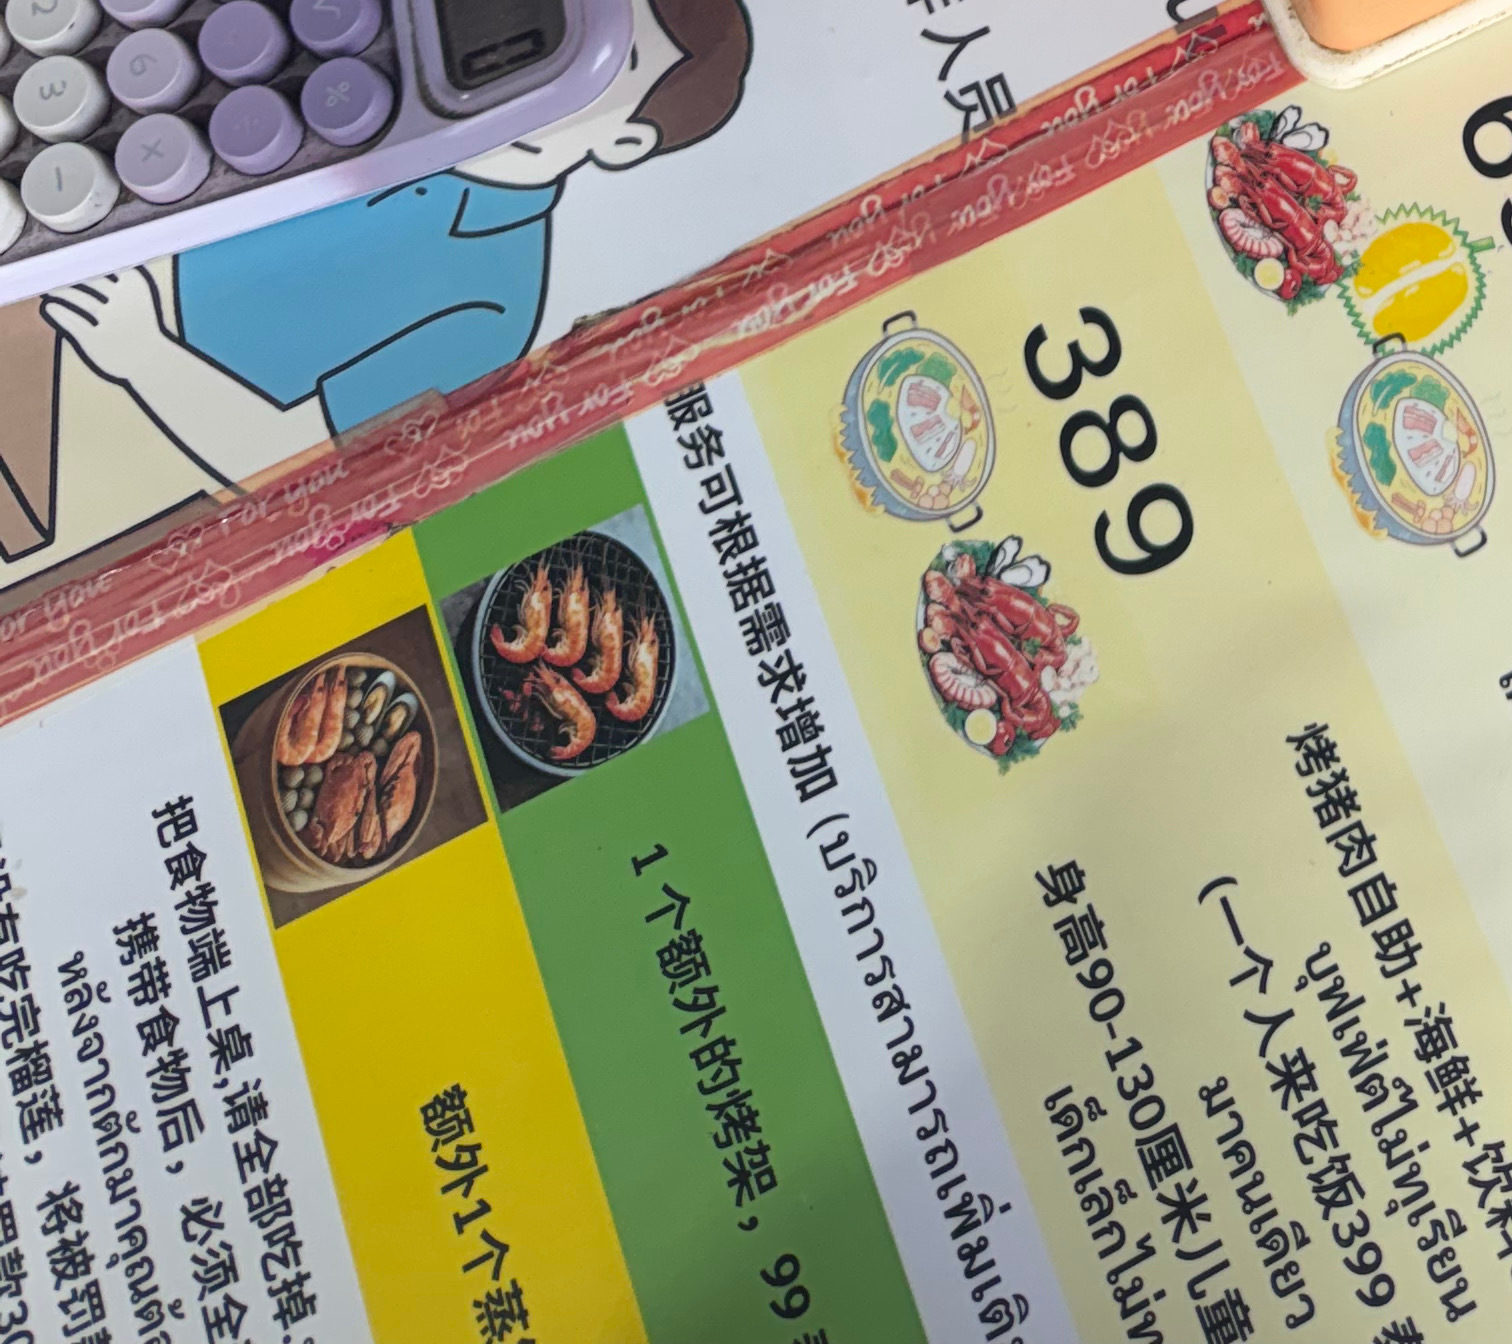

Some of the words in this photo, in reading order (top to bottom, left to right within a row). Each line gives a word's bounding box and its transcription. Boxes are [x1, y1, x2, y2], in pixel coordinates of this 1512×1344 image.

[36, 79, 71, 103] 3
[125, 50, 159, 78] 6
[1023, 306, 1194, 576] 389
[663, 381, 838, 803] 服务可根据需求增加
[112, 912, 251, 1343] 携带食物后，必须全
[419, 1083, 536, 1343] 额外1个蒸
[1198, 1076, 1315, 1330] มาคนเดียว
